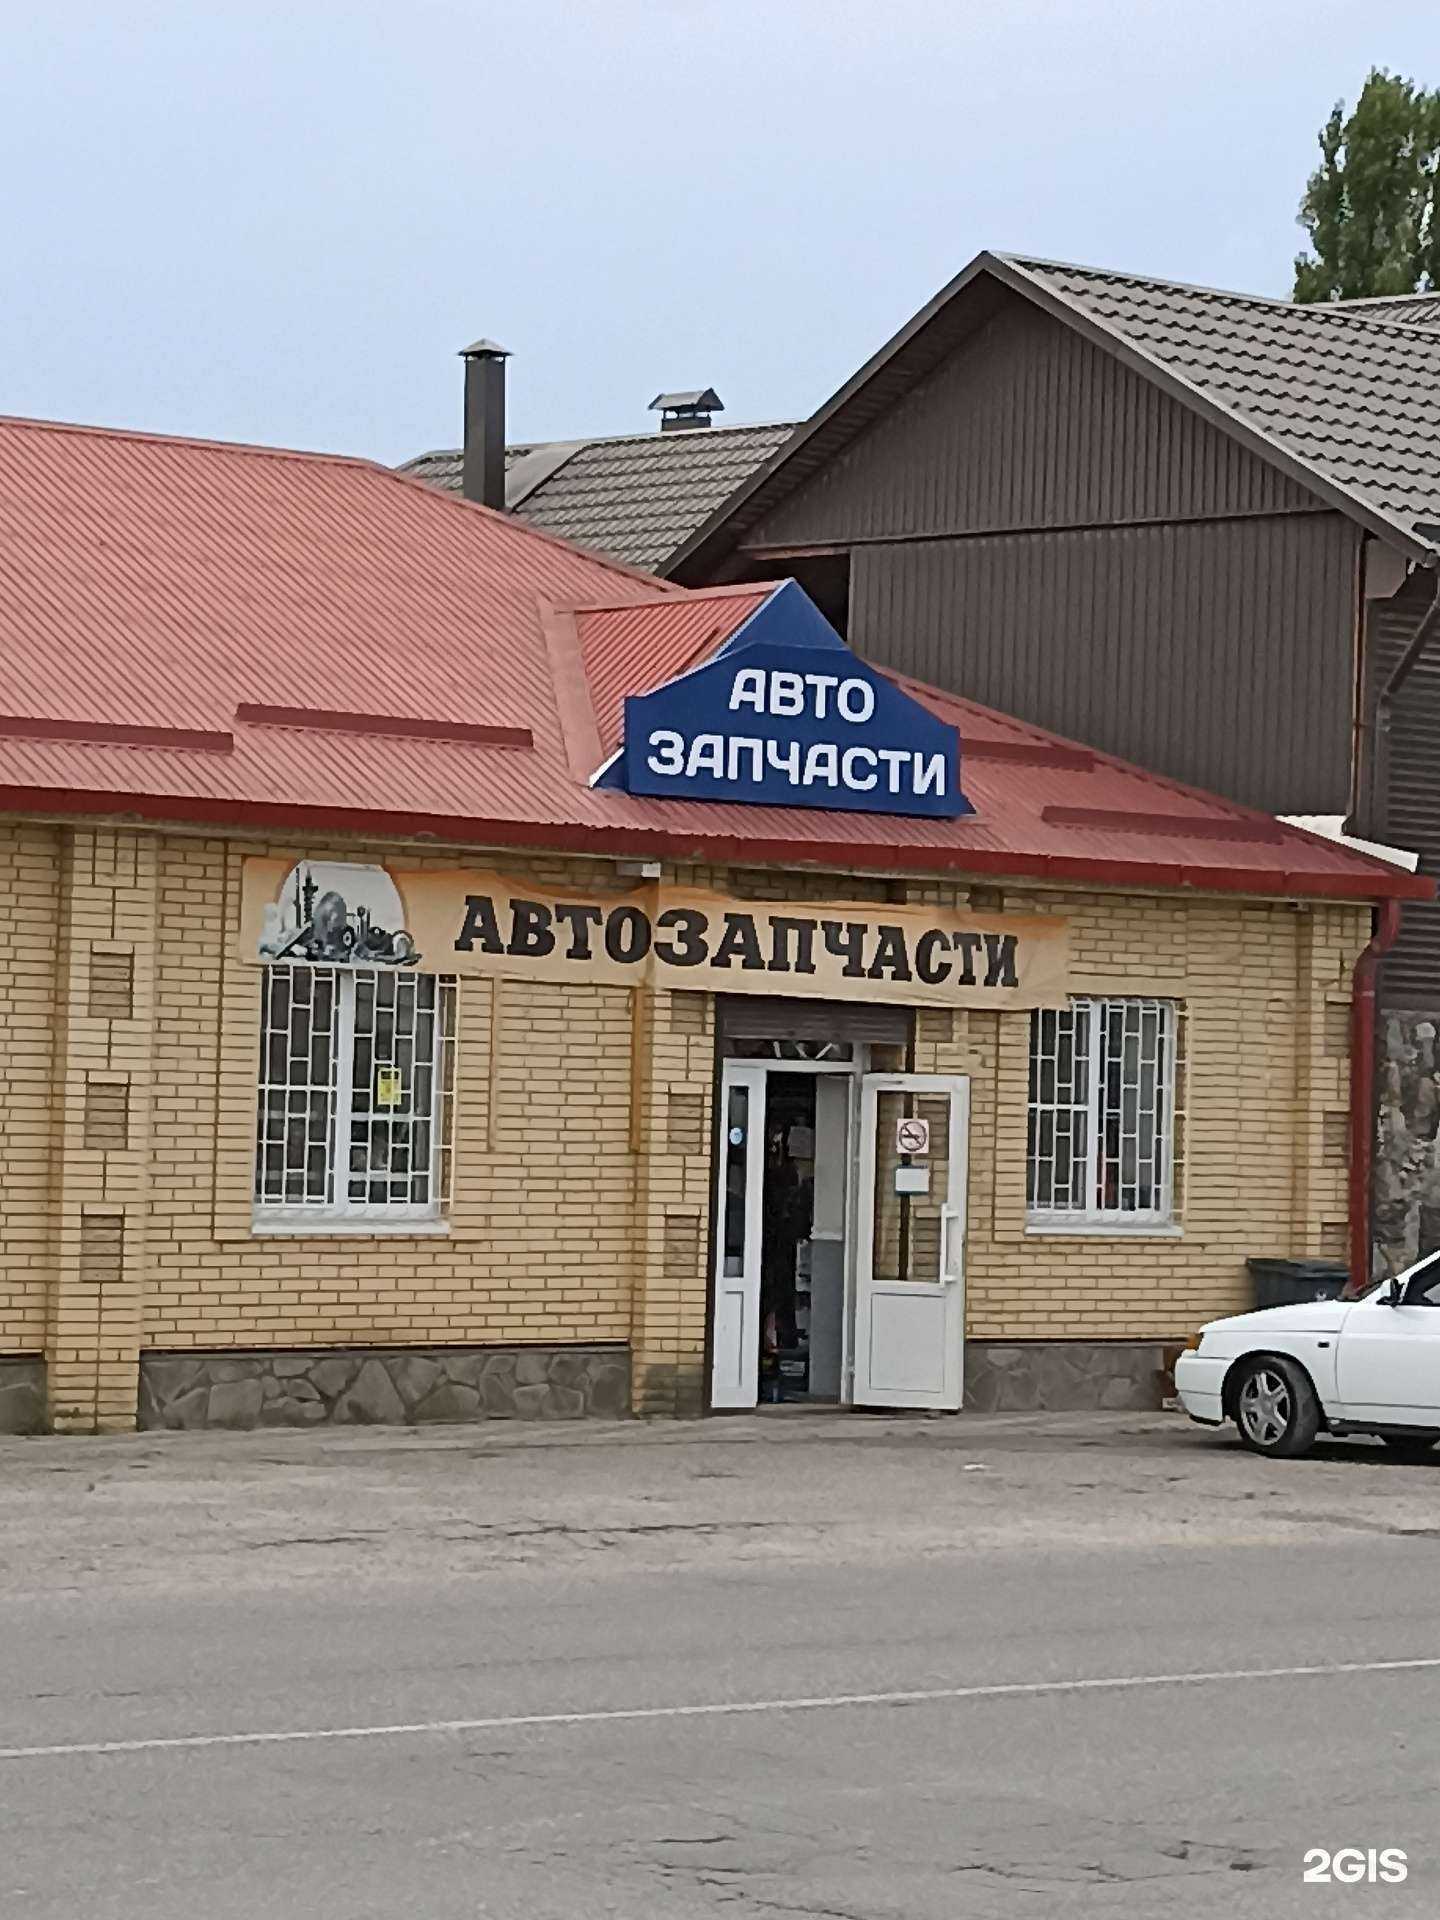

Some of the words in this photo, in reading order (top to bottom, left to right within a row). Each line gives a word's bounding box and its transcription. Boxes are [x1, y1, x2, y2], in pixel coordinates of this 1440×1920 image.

[728, 668, 875, 723] АВТО
[647, 730, 945, 796] ЗАПЧАСТИ
[454, 895, 1019, 987] АВТОЗАПЧАСТИ
